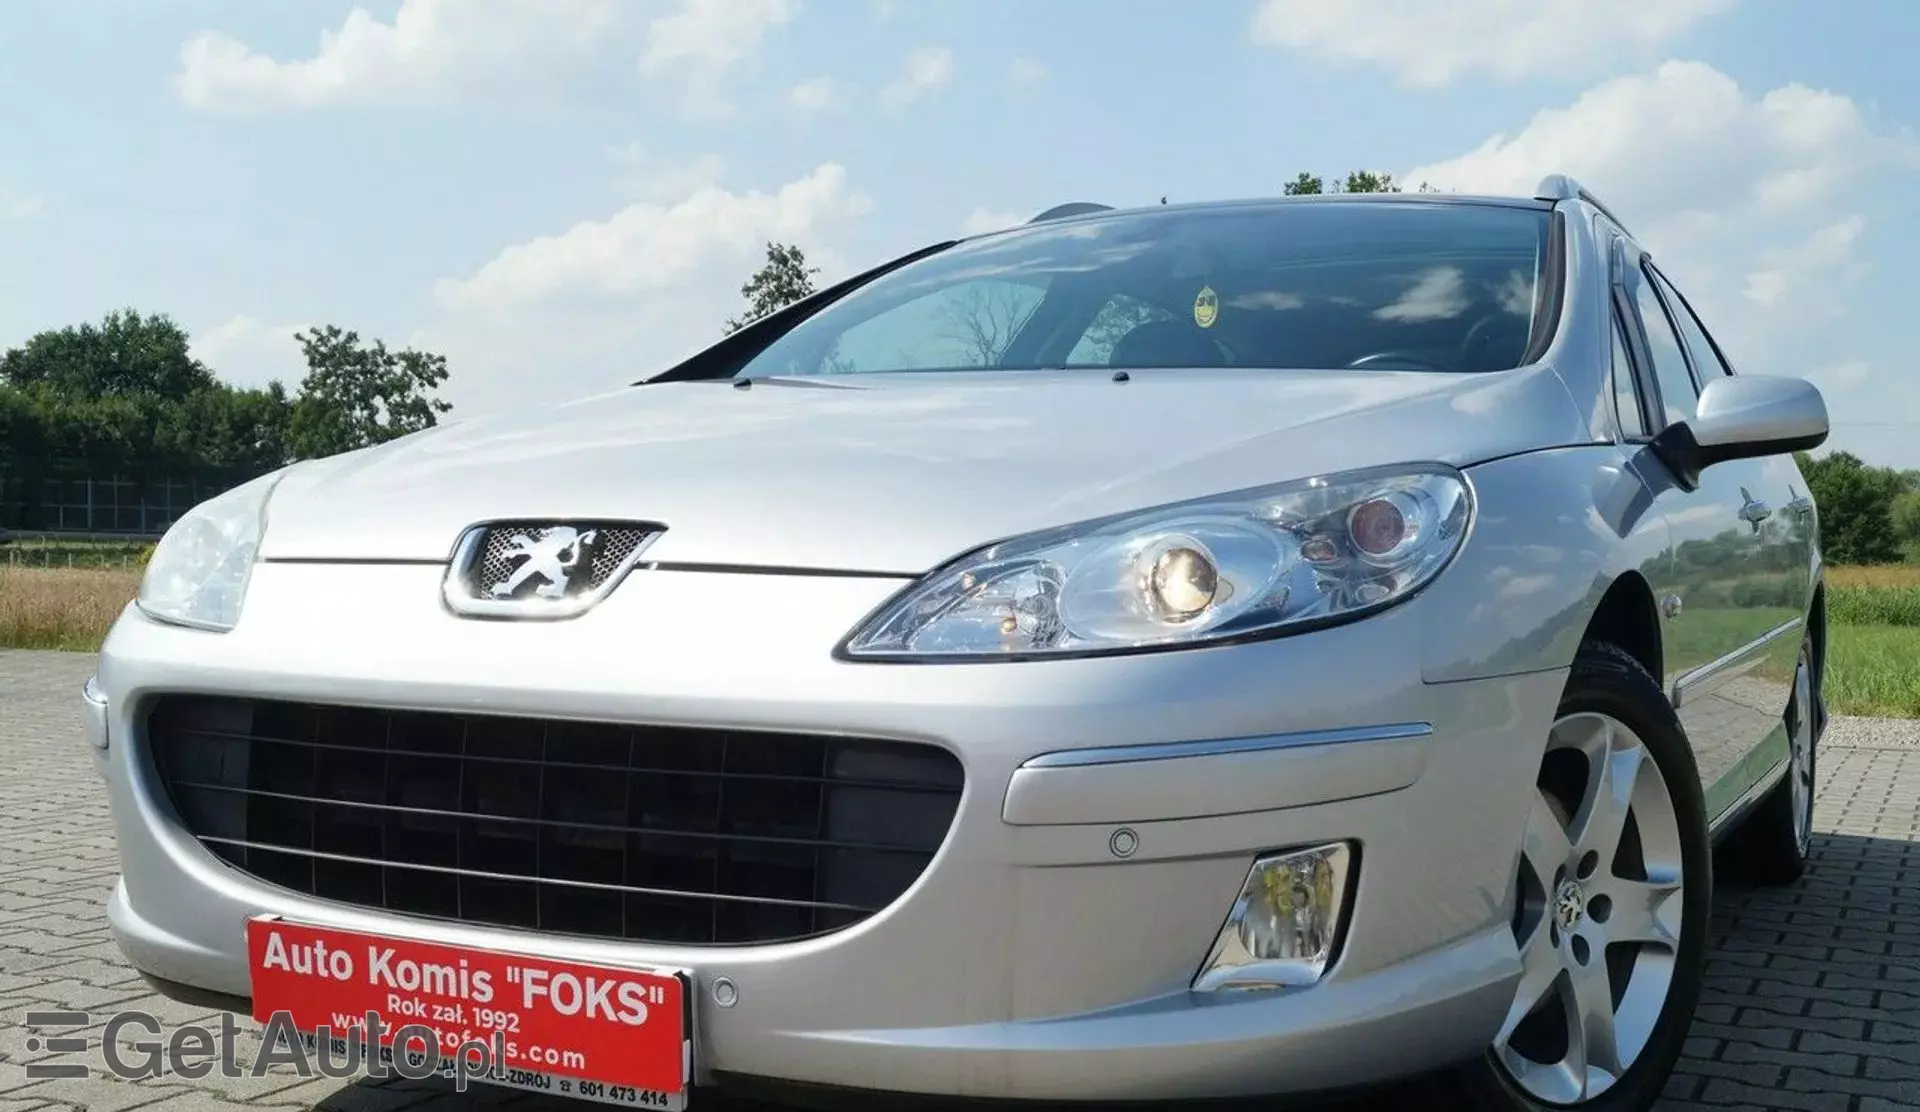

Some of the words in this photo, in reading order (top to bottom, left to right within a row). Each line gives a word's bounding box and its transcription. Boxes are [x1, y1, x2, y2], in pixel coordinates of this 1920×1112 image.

[263, 931, 354, 981] Auto
[368, 944, 494, 1003] Komis
[506, 966, 664, 1026] "FOKS"
[331, 1012, 585, 1070] wwwautofoks.com
[387, 993, 428, 1018] Rok
[432, 1000, 468, 1025] zał.
[472, 1007, 520, 1034] 1992
[307, 1033, 346, 1055] KIS
[579, 1080, 604, 1097] 601
[609, 1085, 636, 1102] 473
[640, 1090, 668, 1107] 414
